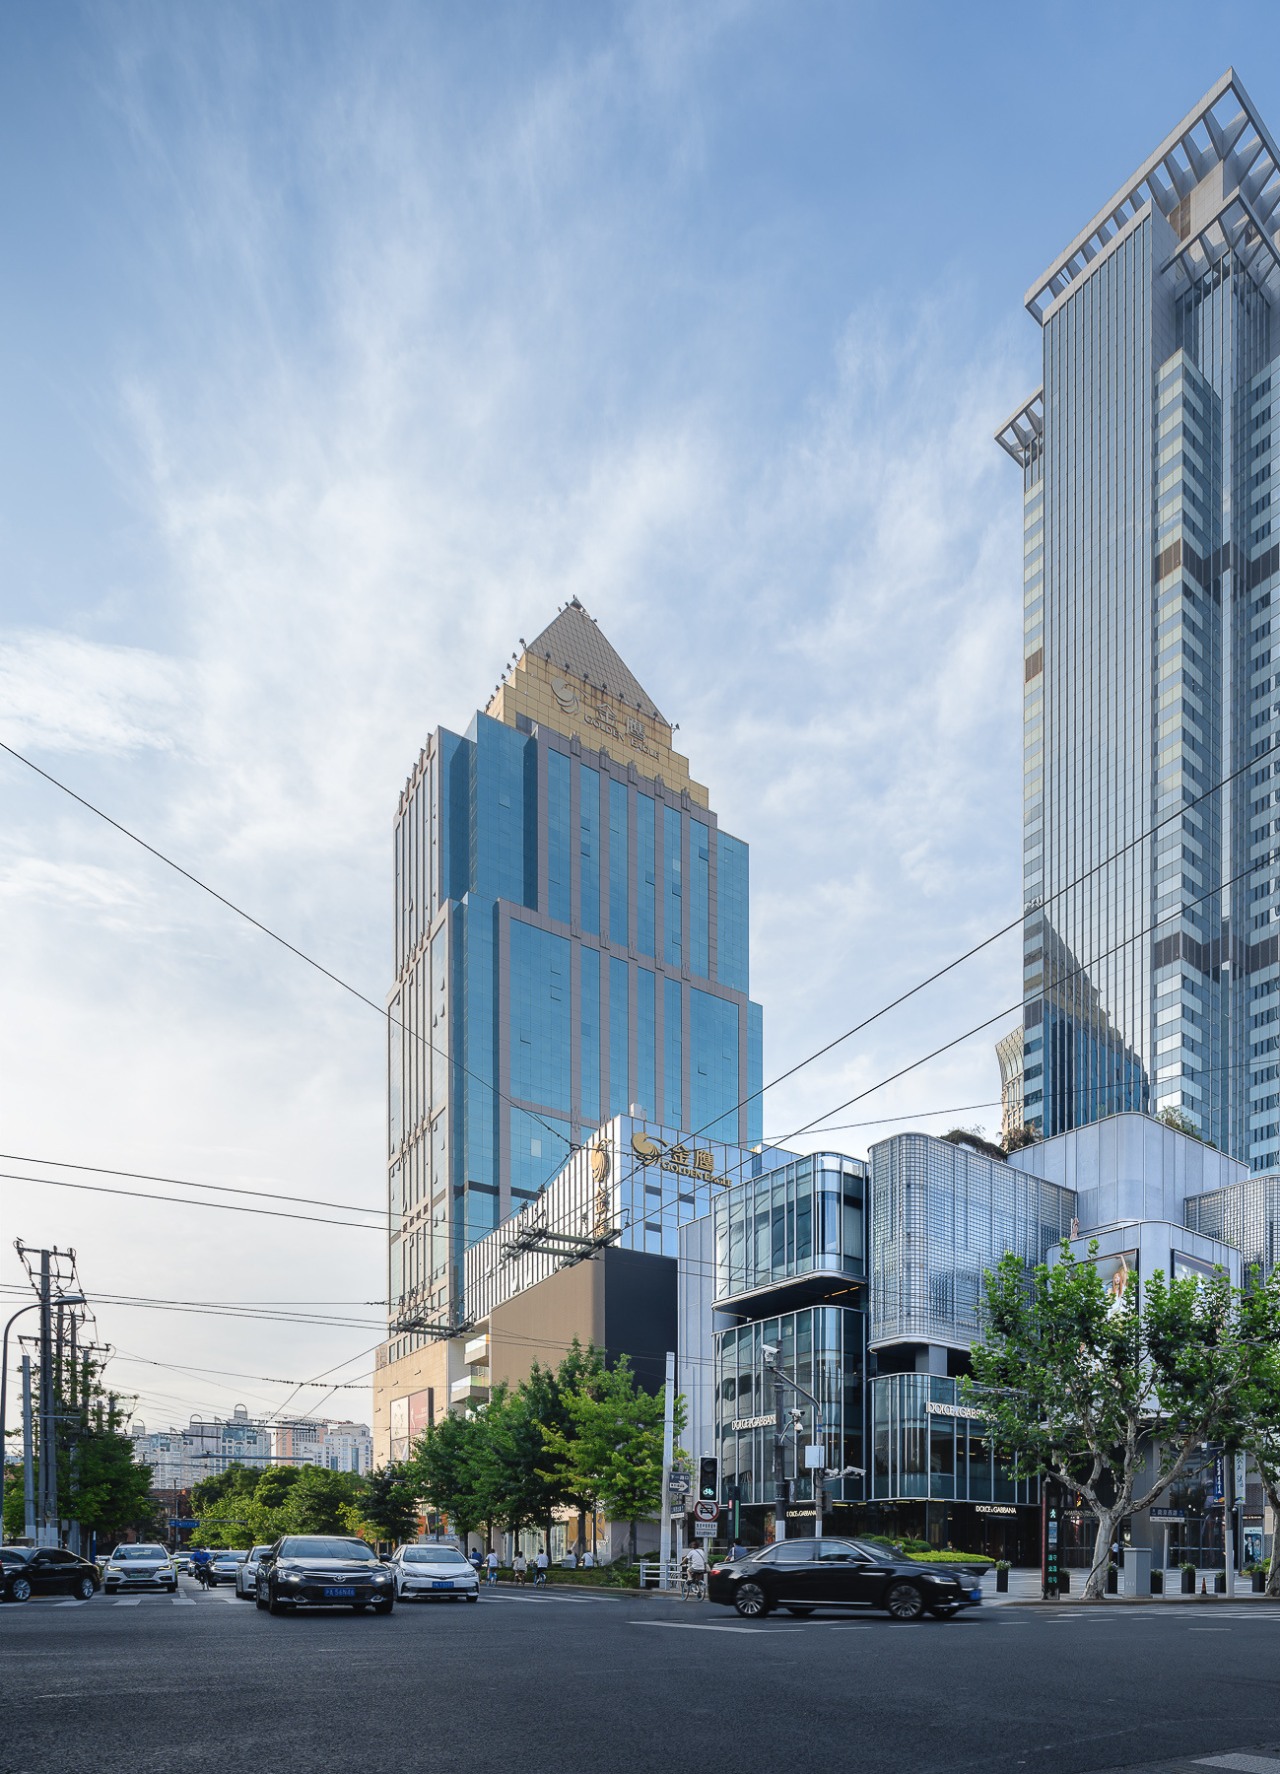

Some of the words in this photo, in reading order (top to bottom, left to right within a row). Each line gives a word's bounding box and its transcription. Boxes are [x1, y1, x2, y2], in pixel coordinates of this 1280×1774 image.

[584, 714, 624, 742] GOLDEN
[630, 737, 660, 761] EAGLE
[661, 1161, 703, 1182] GOLDEN
[704, 1171, 732, 1187] EAGLE
